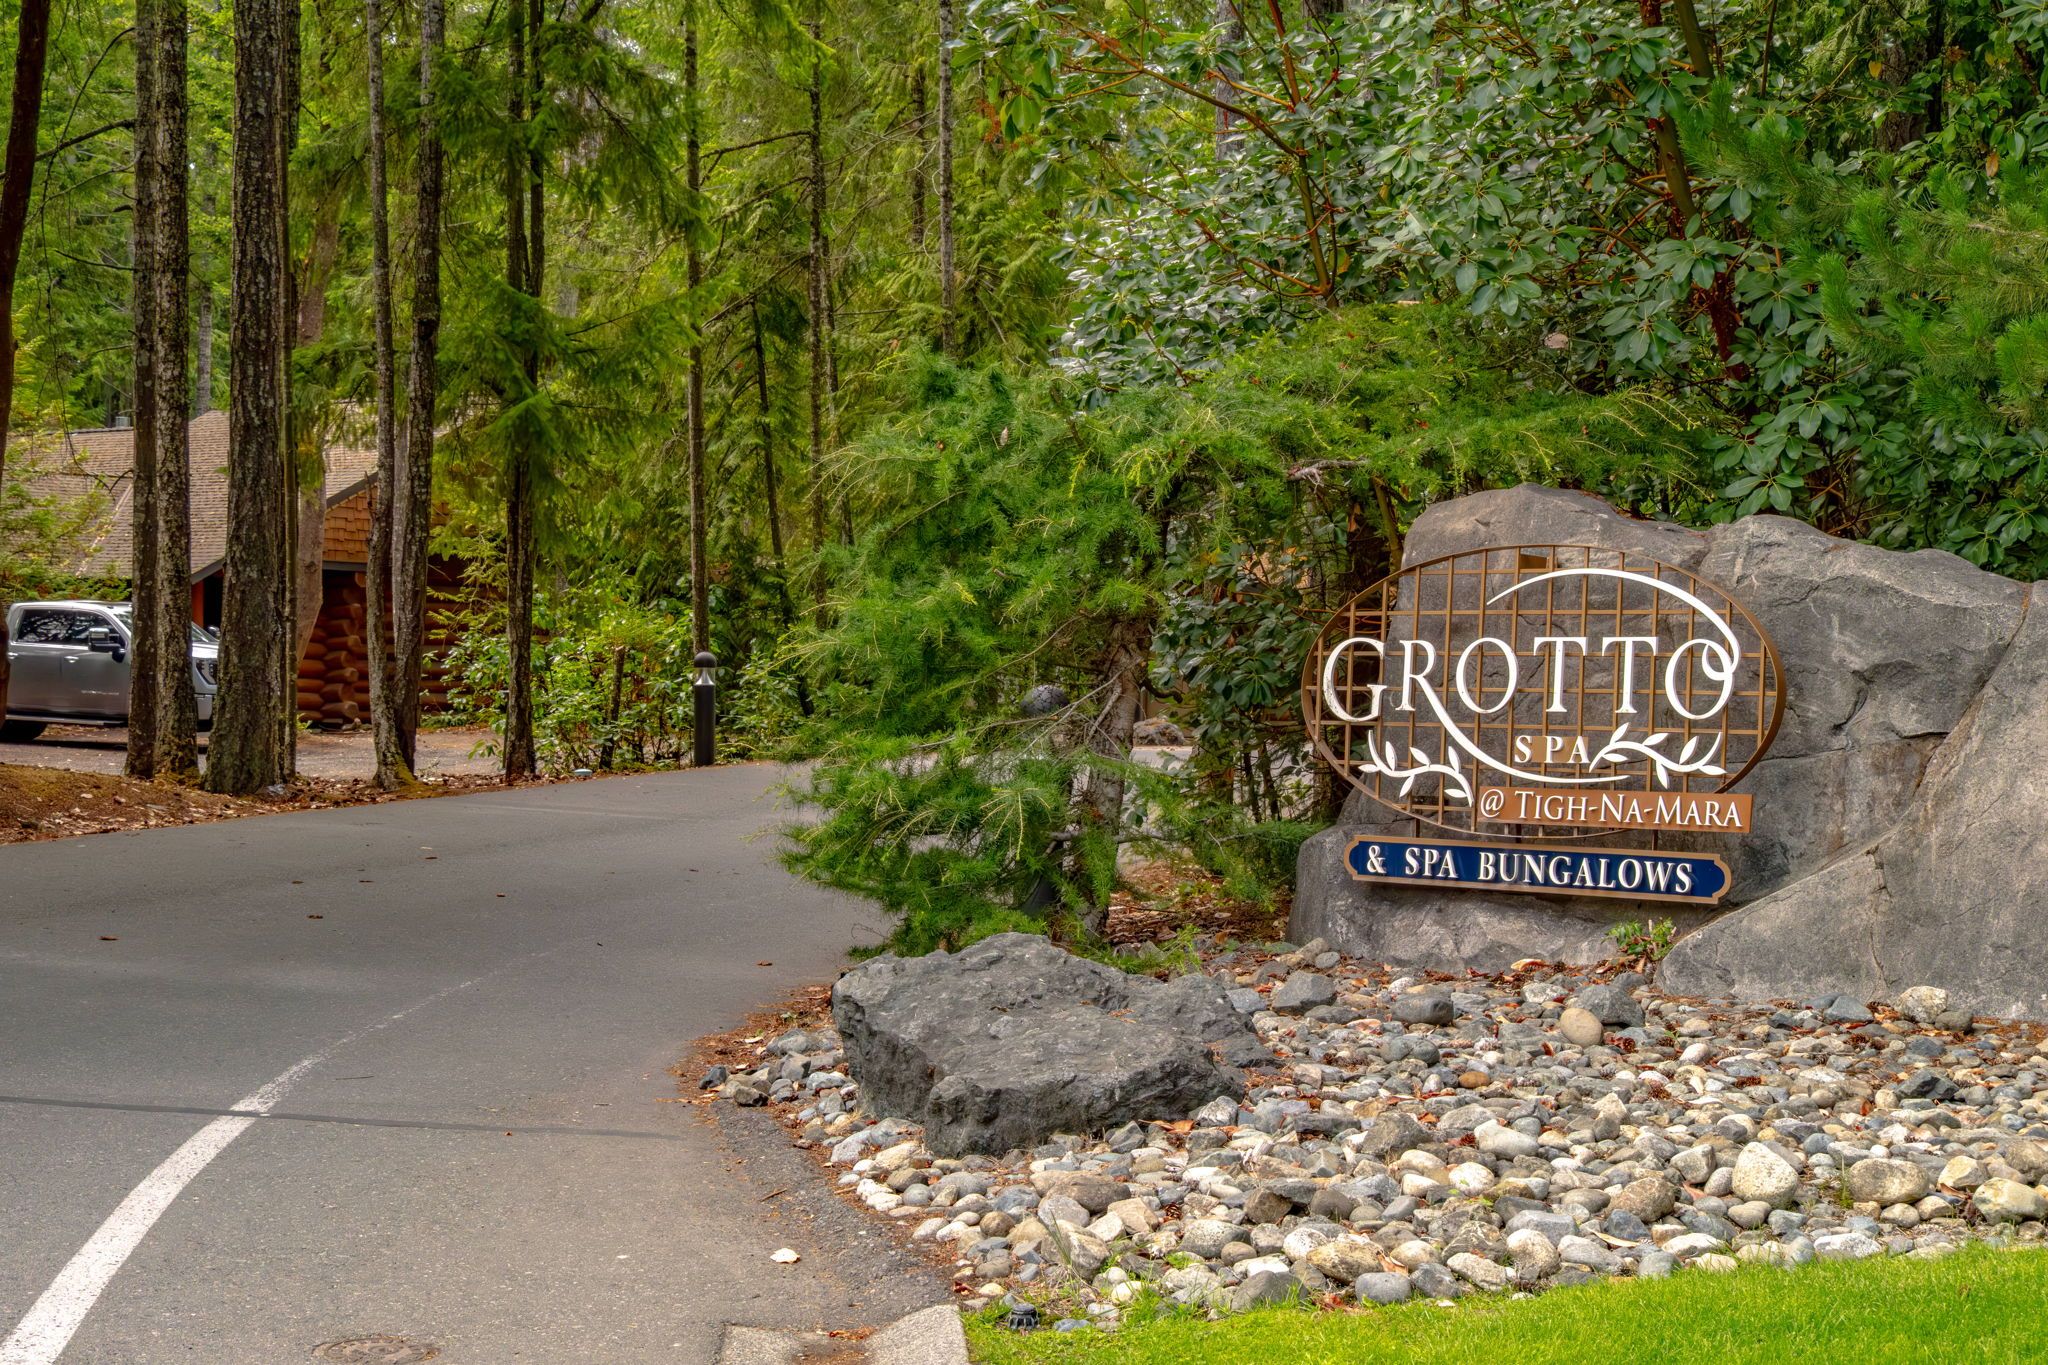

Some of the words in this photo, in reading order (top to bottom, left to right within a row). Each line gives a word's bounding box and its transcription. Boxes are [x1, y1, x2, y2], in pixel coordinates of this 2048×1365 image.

[1322, 636, 1740, 783] GROTTO
[1514, 735, 1591, 764] SPA
[1481, 788, 1505, 819] @
[1515, 790, 1743, 827] TIGH-NA-MARA
[1366, 845, 1386, 874] &
[1405, 847, 1458, 878] SPA
[1478, 851, 1693, 893] BUNGALOWS
